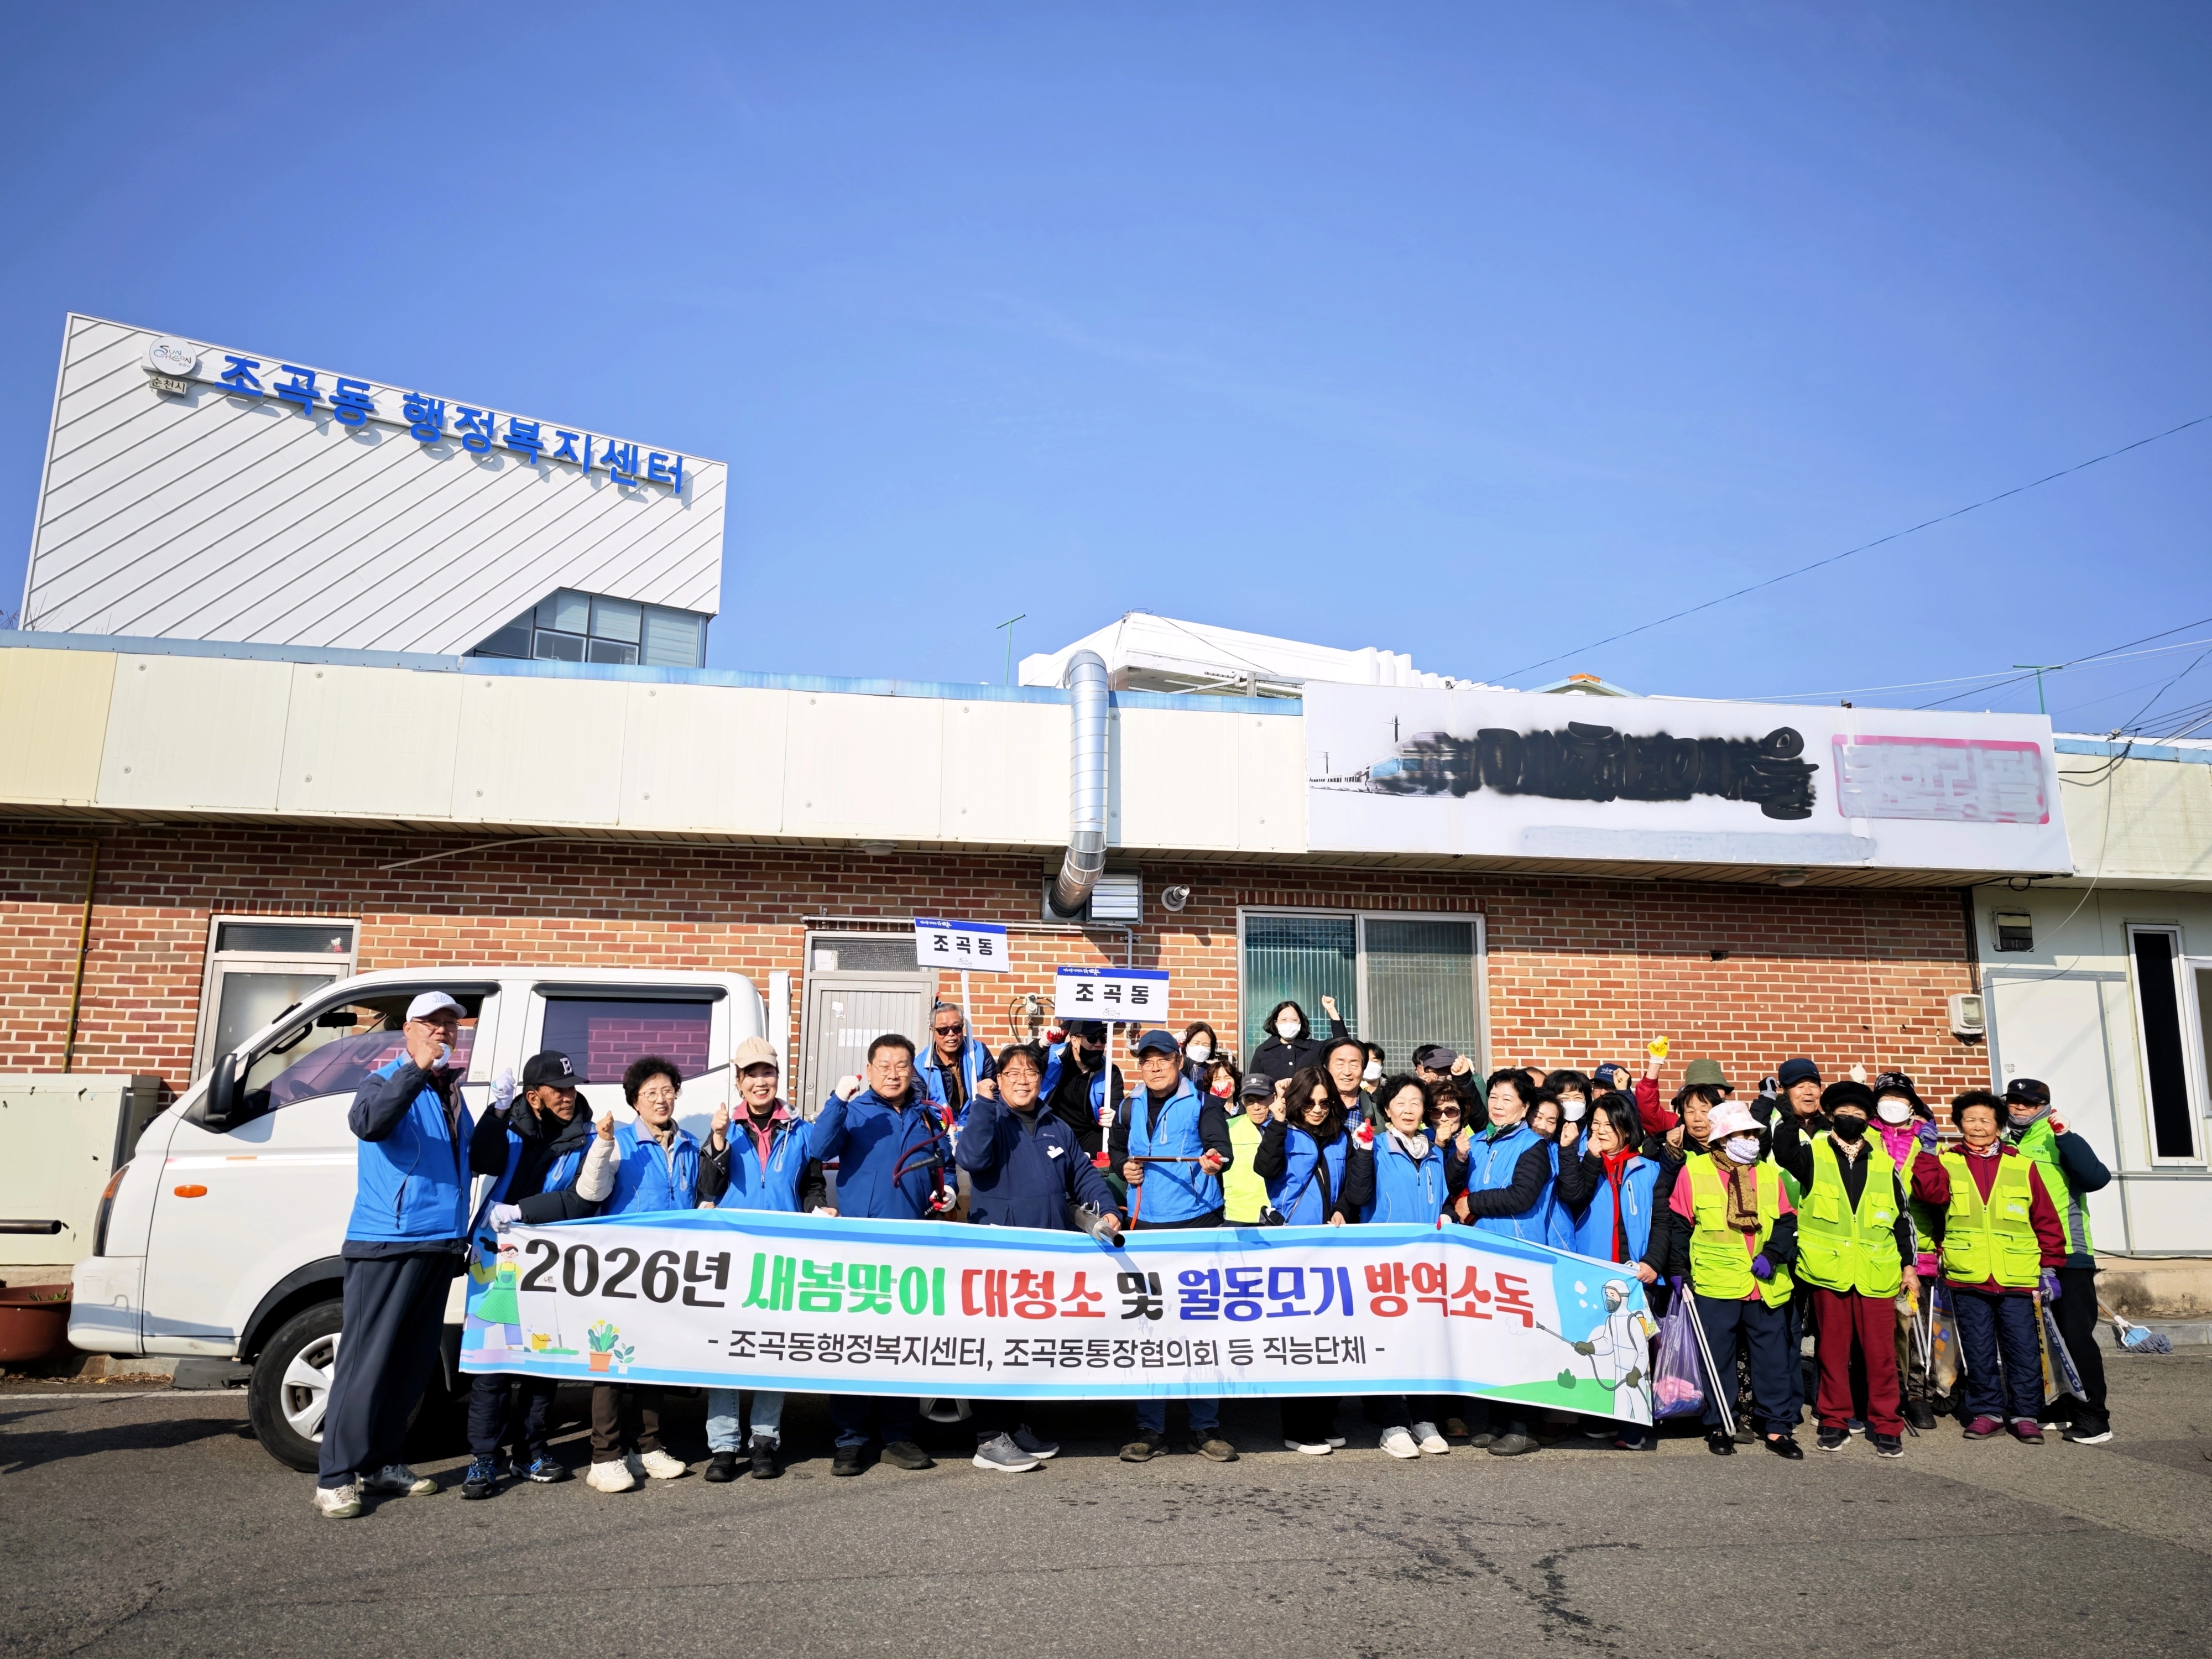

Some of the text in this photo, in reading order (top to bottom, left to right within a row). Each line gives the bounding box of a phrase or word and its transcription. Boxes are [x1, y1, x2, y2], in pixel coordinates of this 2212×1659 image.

[150, 377, 185, 393] 순천시
[214, 355, 684, 494] 조곡동 행정복지센터
[933, 934, 993, 956] 조곡동
[1075, 983, 1150, 1005] 조곡동
[560, 1057, 573, 1075] B
[520, 1238, 1533, 1328] 2026년 새봄맞이 대청소 및 월동모기 방역소독
[728, 1329, 993, 1372] 조곡동행정복지센터,
[1003, 1338, 1219, 1369] 조곡동통장협의회
[1228, 1338, 1254, 1366] 등
[1262, 1335, 1366, 1366] 직능단체
[646, 1457, 656, 1465] N
